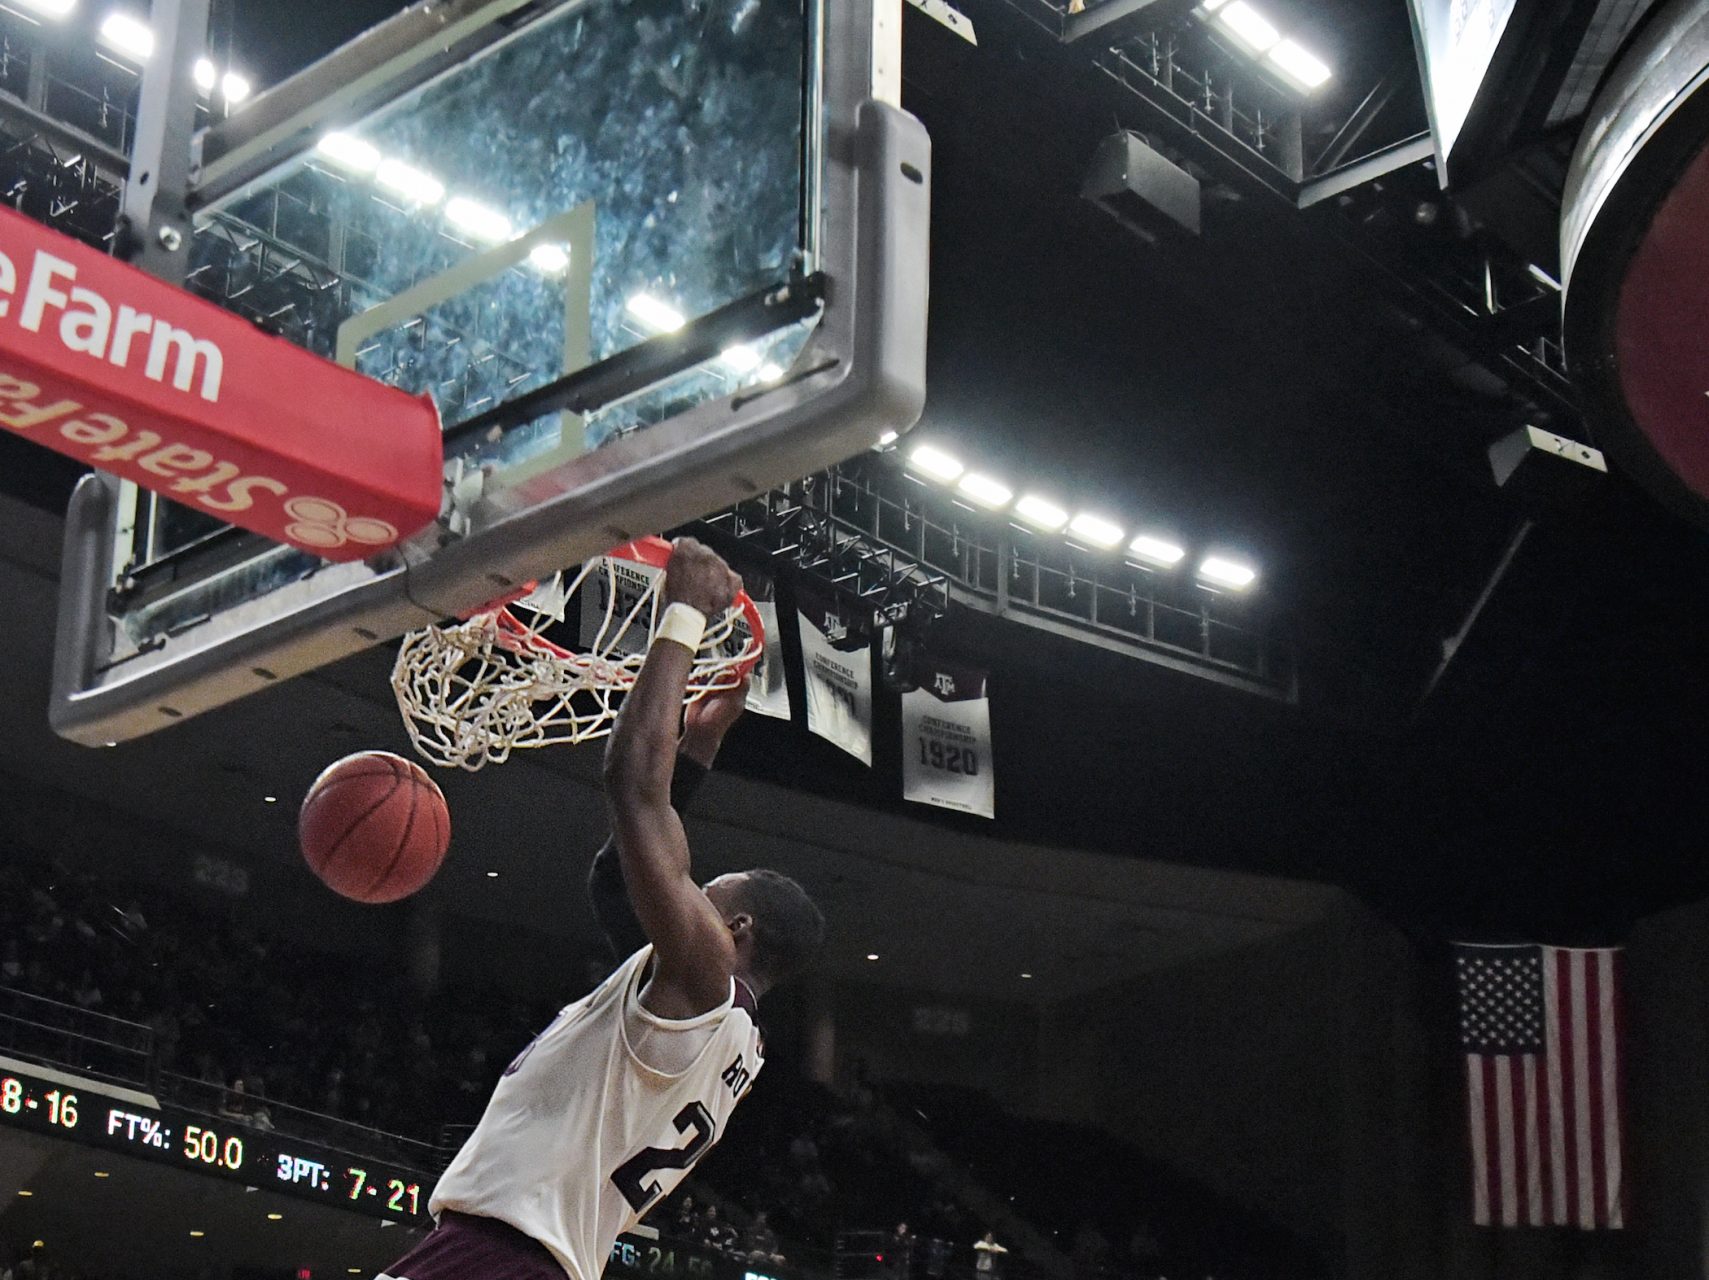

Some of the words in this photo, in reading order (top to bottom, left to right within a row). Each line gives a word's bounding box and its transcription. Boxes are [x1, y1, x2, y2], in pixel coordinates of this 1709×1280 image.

[918, 736, 979, 776] 1920
[107, 1109, 171, 1150] FT%:
[184, 1125, 243, 1170] 50.0
[277, 1153, 330, 1191] 3PT:
[610, 1100, 716, 1215] 2
